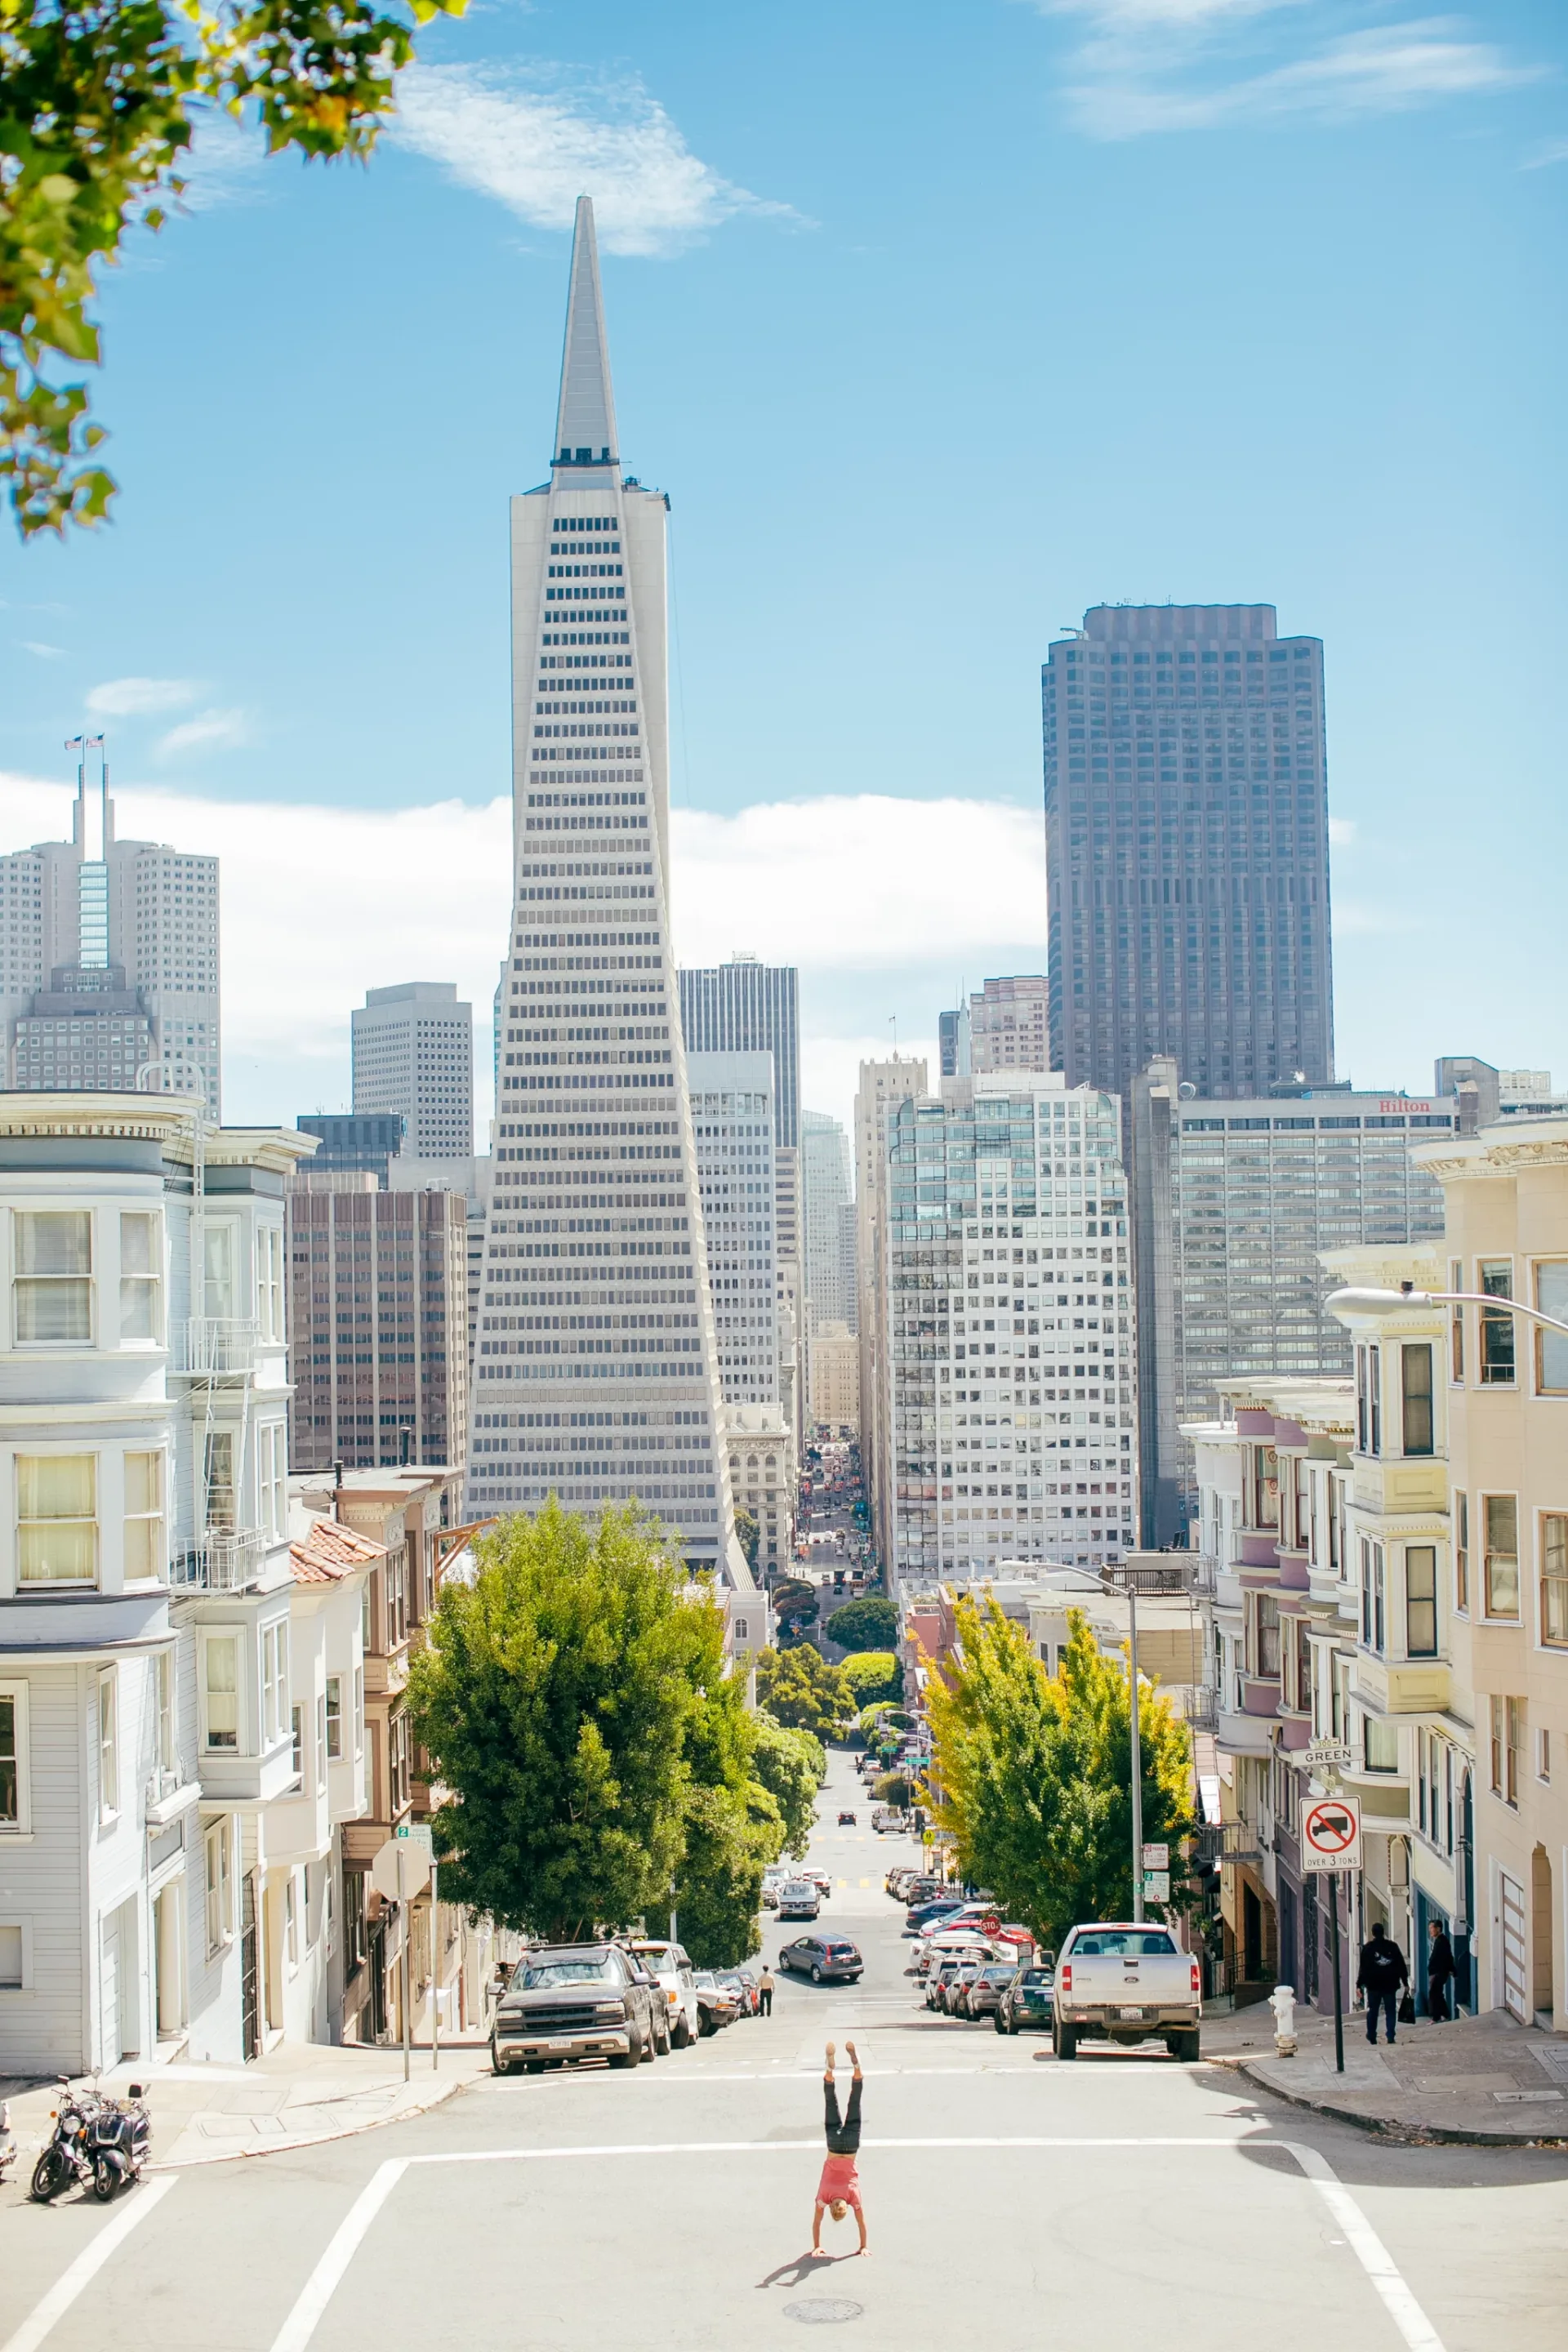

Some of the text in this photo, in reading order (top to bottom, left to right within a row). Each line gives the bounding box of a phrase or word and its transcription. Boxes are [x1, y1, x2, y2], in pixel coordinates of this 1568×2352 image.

[1379, 1099, 1430, 1112] Hilton
[1305, 1749, 1352, 1762] GREEN
[400, 1828, 407, 1836] 2
[1330, 1855, 1336, 1866] 3
[982, 1922, 998, 1931] STO
